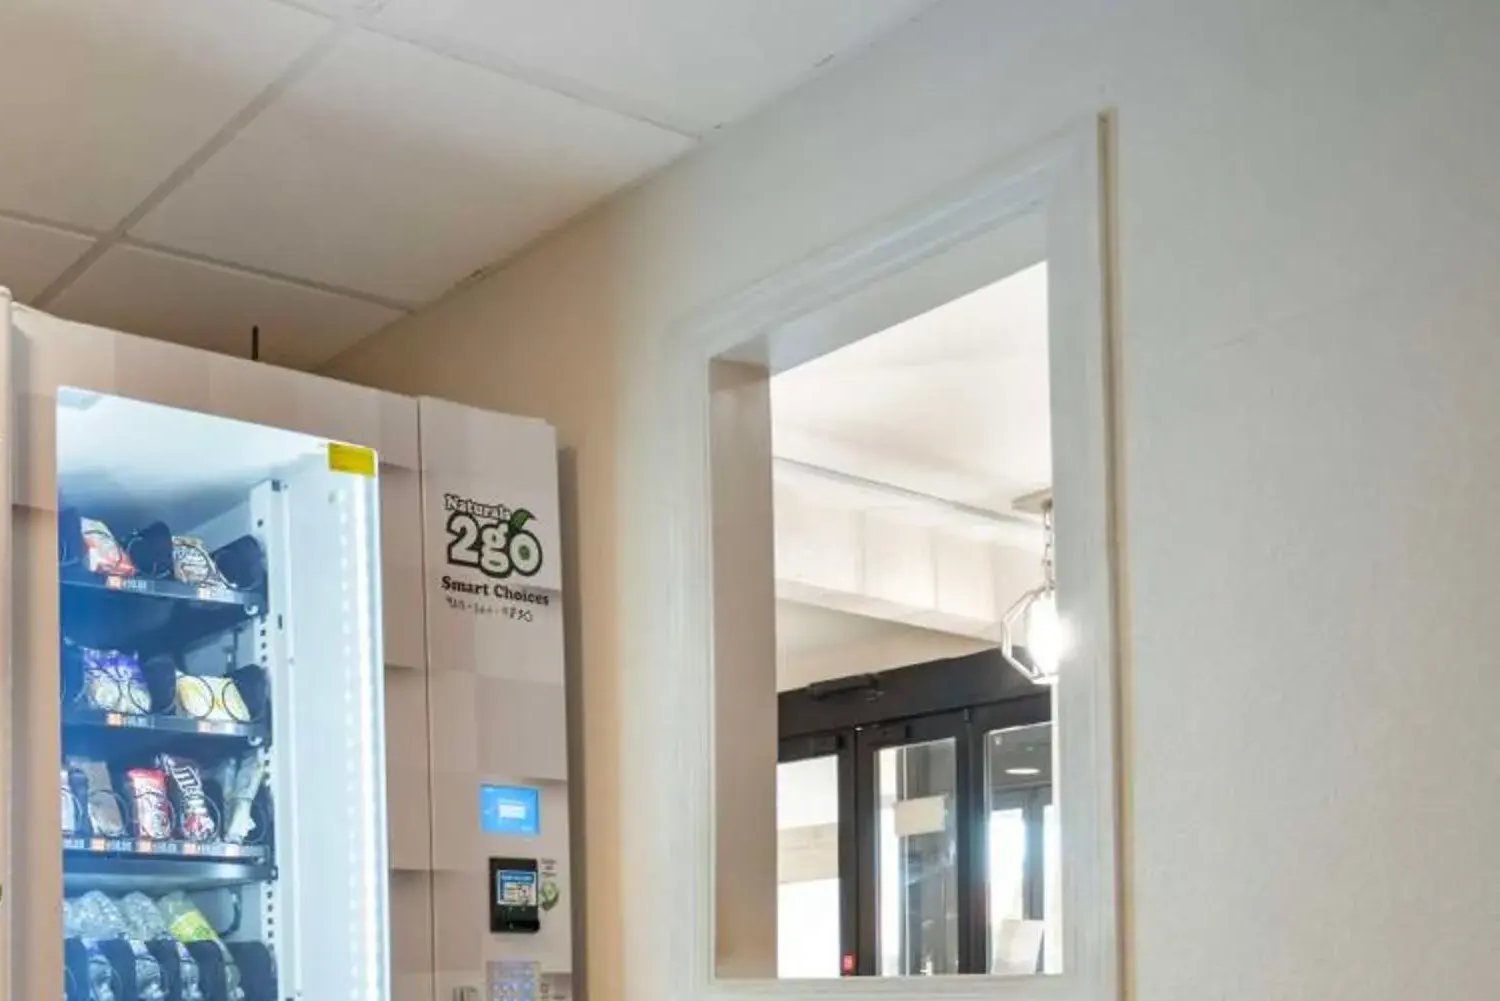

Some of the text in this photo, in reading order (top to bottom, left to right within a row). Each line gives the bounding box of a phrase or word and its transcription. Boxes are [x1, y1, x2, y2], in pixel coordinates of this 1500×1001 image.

[443, 493, 512, 520] Naturals
[446, 510, 542, 578] 2go
[441, 575, 550, 606] Smart Choices
